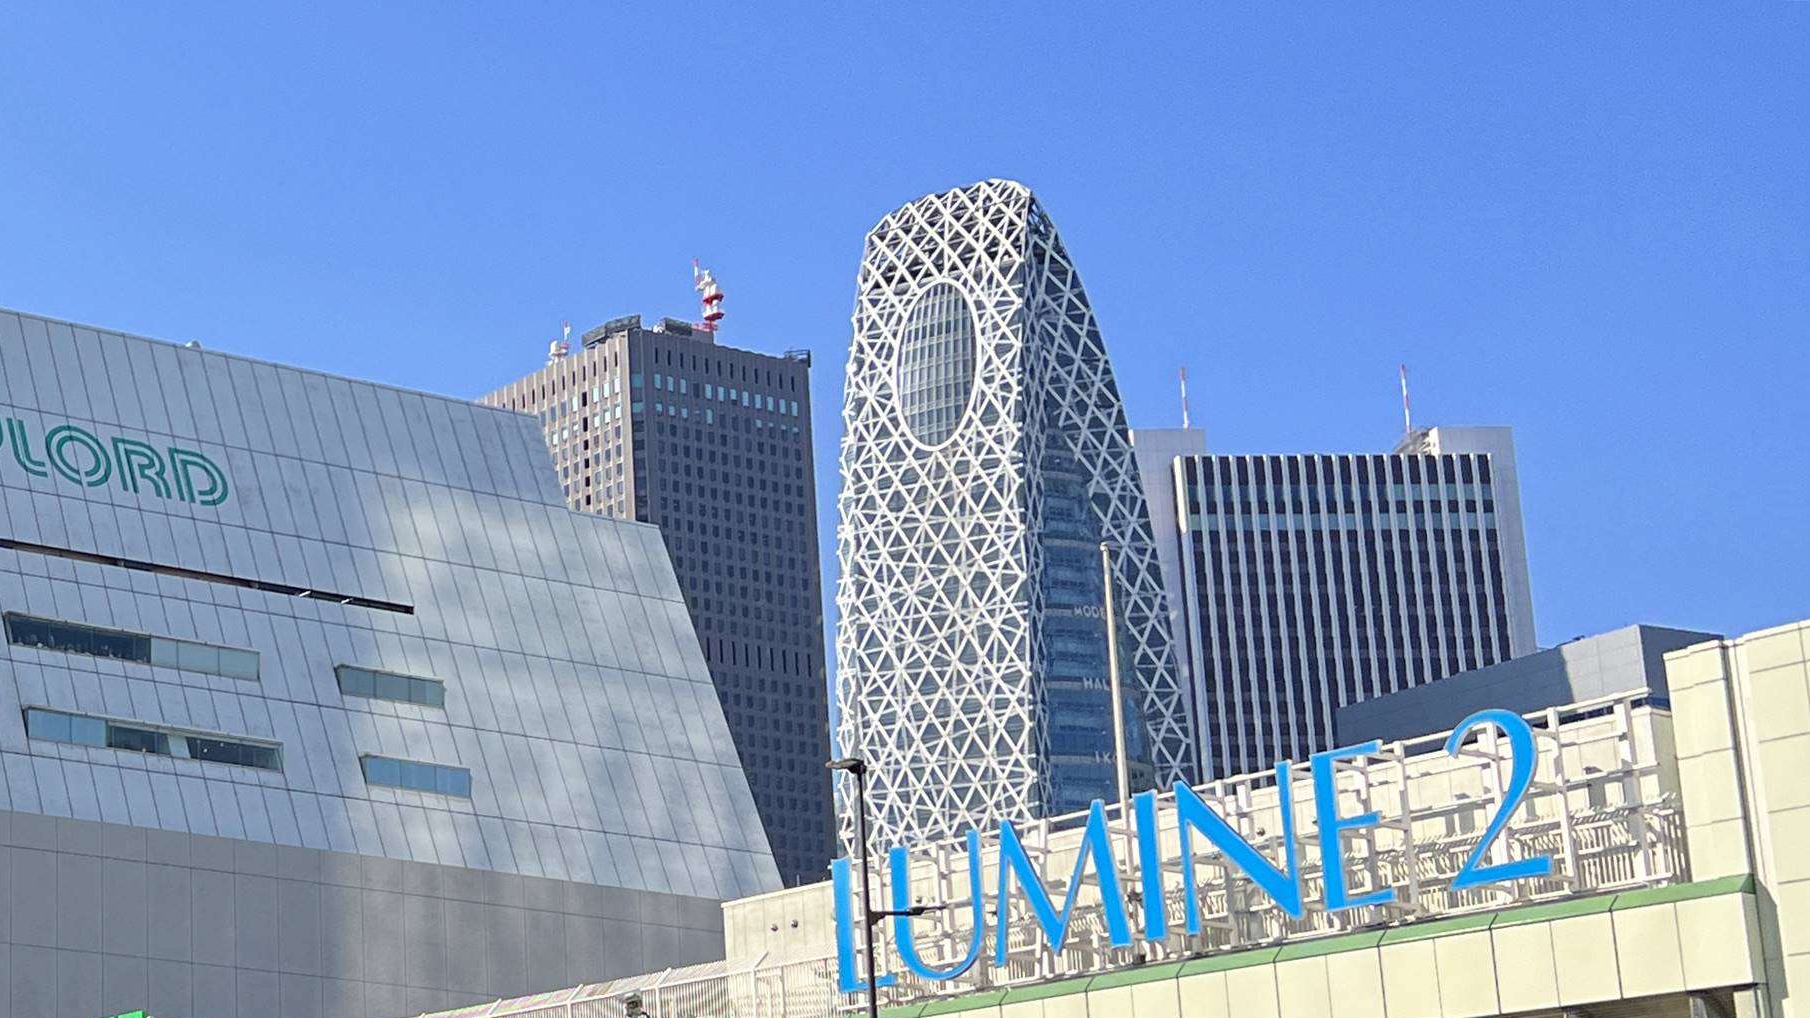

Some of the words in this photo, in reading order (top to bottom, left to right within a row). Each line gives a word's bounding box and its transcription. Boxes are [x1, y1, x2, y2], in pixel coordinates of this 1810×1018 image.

[1083, 676, 1110, 690] HAL
[829, 738, 1396, 994] LUMINE
[1444, 707, 1555, 891] 2
